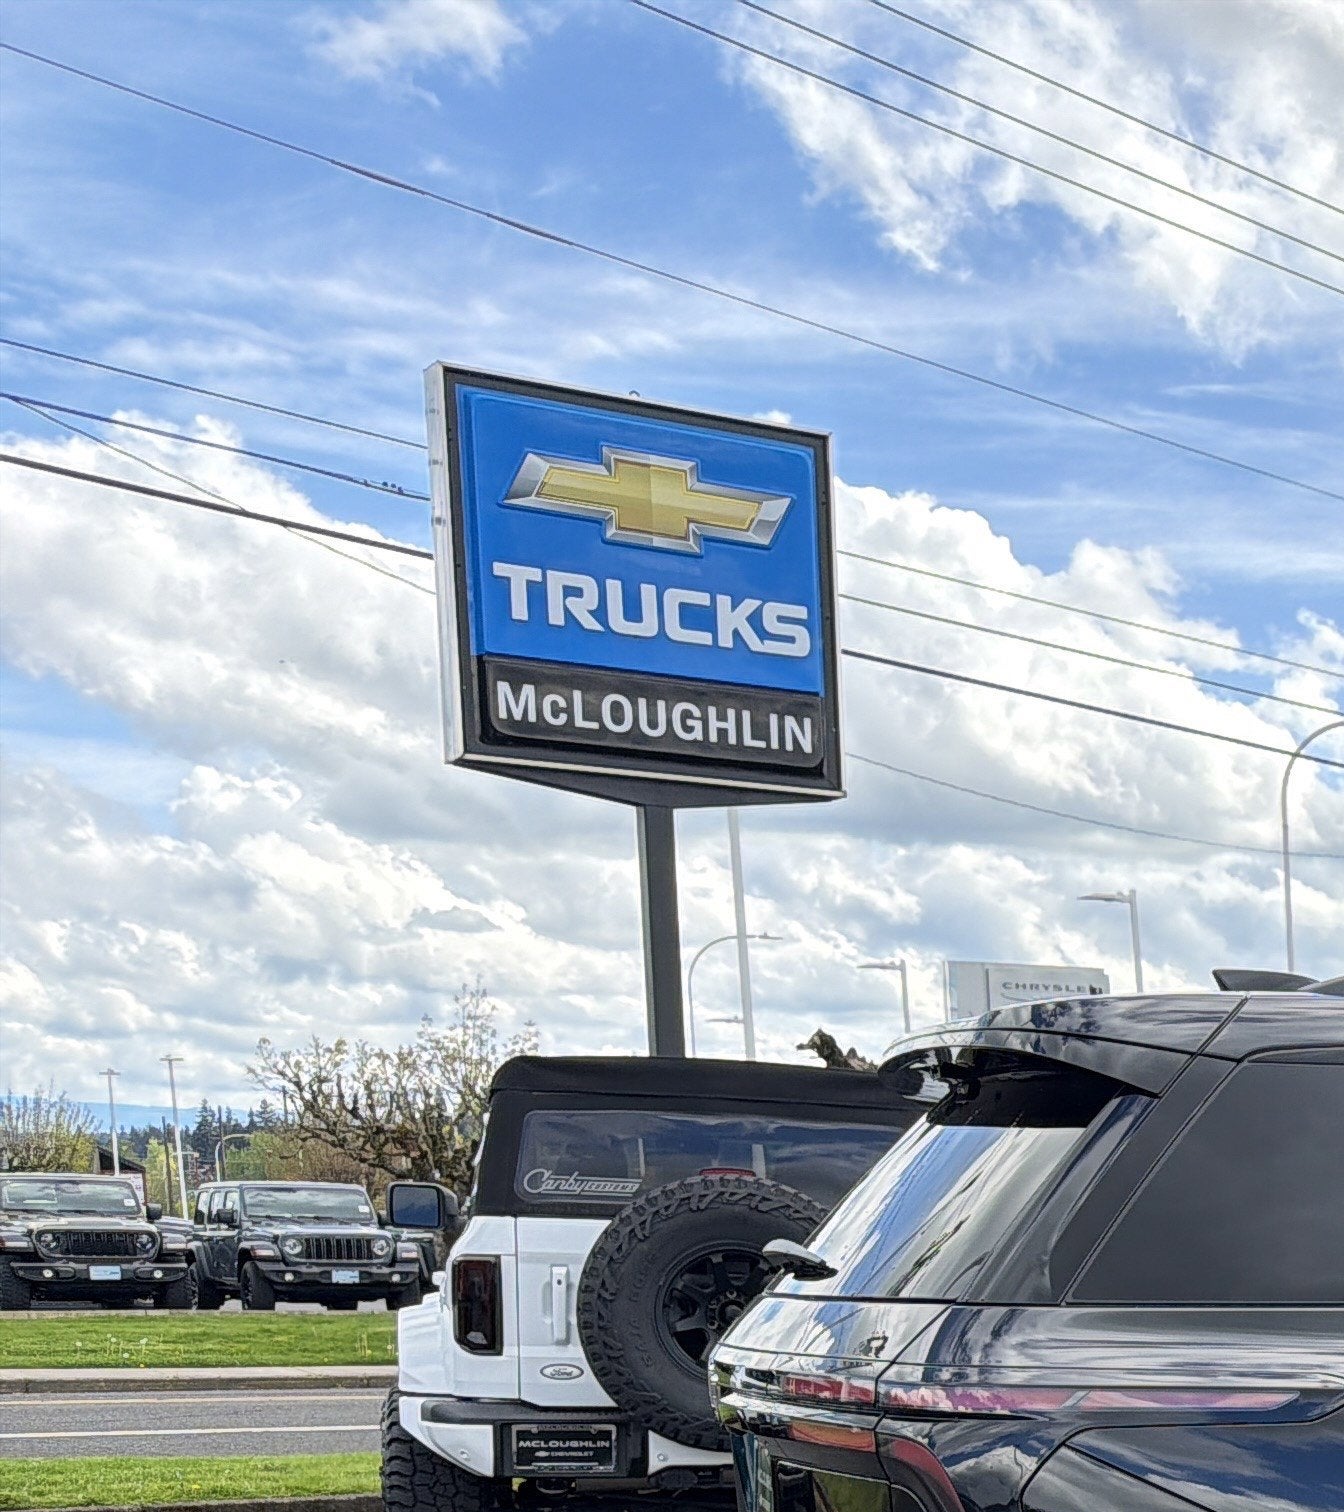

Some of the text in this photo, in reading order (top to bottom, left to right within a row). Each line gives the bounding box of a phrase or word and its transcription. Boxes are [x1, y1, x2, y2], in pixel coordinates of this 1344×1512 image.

[493, 561, 811, 658] TRUCKS
[496, 680, 813, 754] McLOUGHLIN
[1002, 981, 1098, 994] CHRYSLE
[523, 1168, 586, 1197] Canby
[518, 1440, 611, 1448] MCLOUGHLIN
